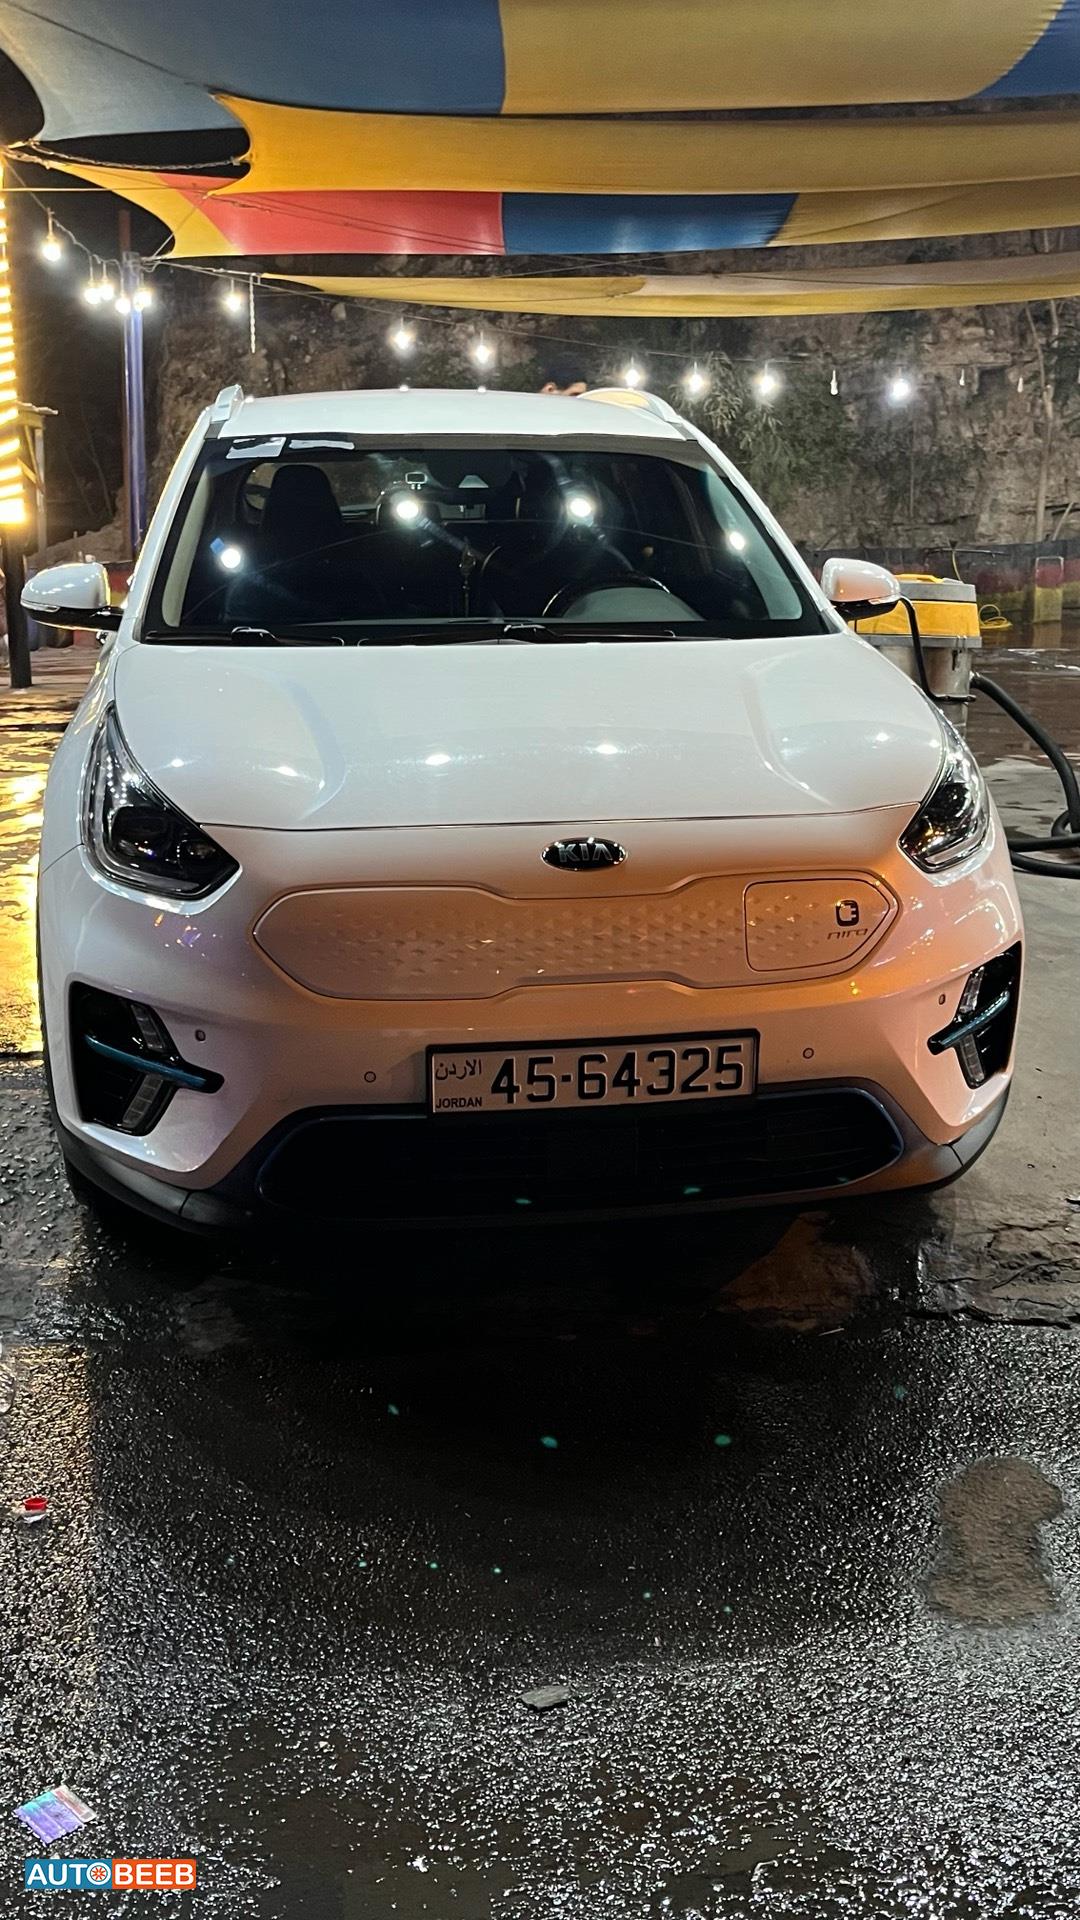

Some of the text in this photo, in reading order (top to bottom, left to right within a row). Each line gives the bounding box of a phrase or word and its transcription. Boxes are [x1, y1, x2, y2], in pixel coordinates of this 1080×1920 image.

[558, 843, 614, 862] KIA
[827, 928, 868, 940] niro
[490, 1045, 744, 1104] 45-64325
[435, 1096, 482, 1109] JORDAN
